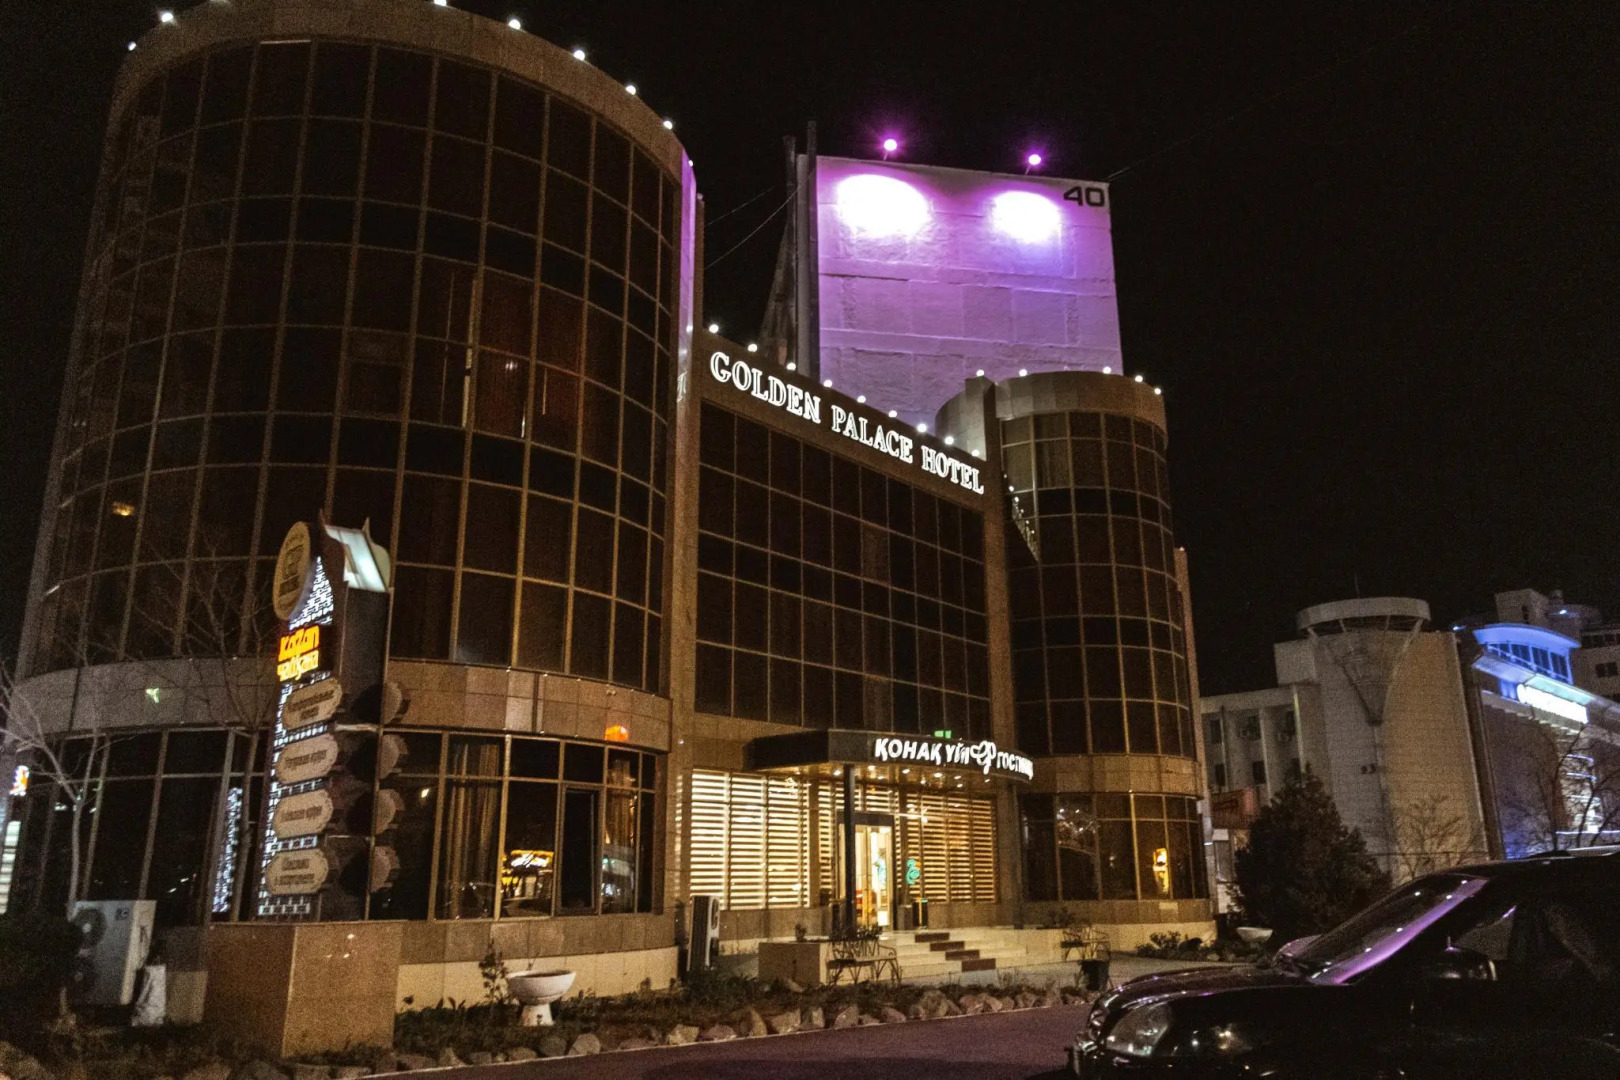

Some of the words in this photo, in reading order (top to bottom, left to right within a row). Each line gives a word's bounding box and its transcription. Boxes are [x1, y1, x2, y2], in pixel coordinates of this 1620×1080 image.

[1063, 186, 1105, 207] 40
[709, 351, 822, 424] GOLDEN
[831, 404, 914, 464] PALACE
[920, 445, 985, 495] HOTEL
